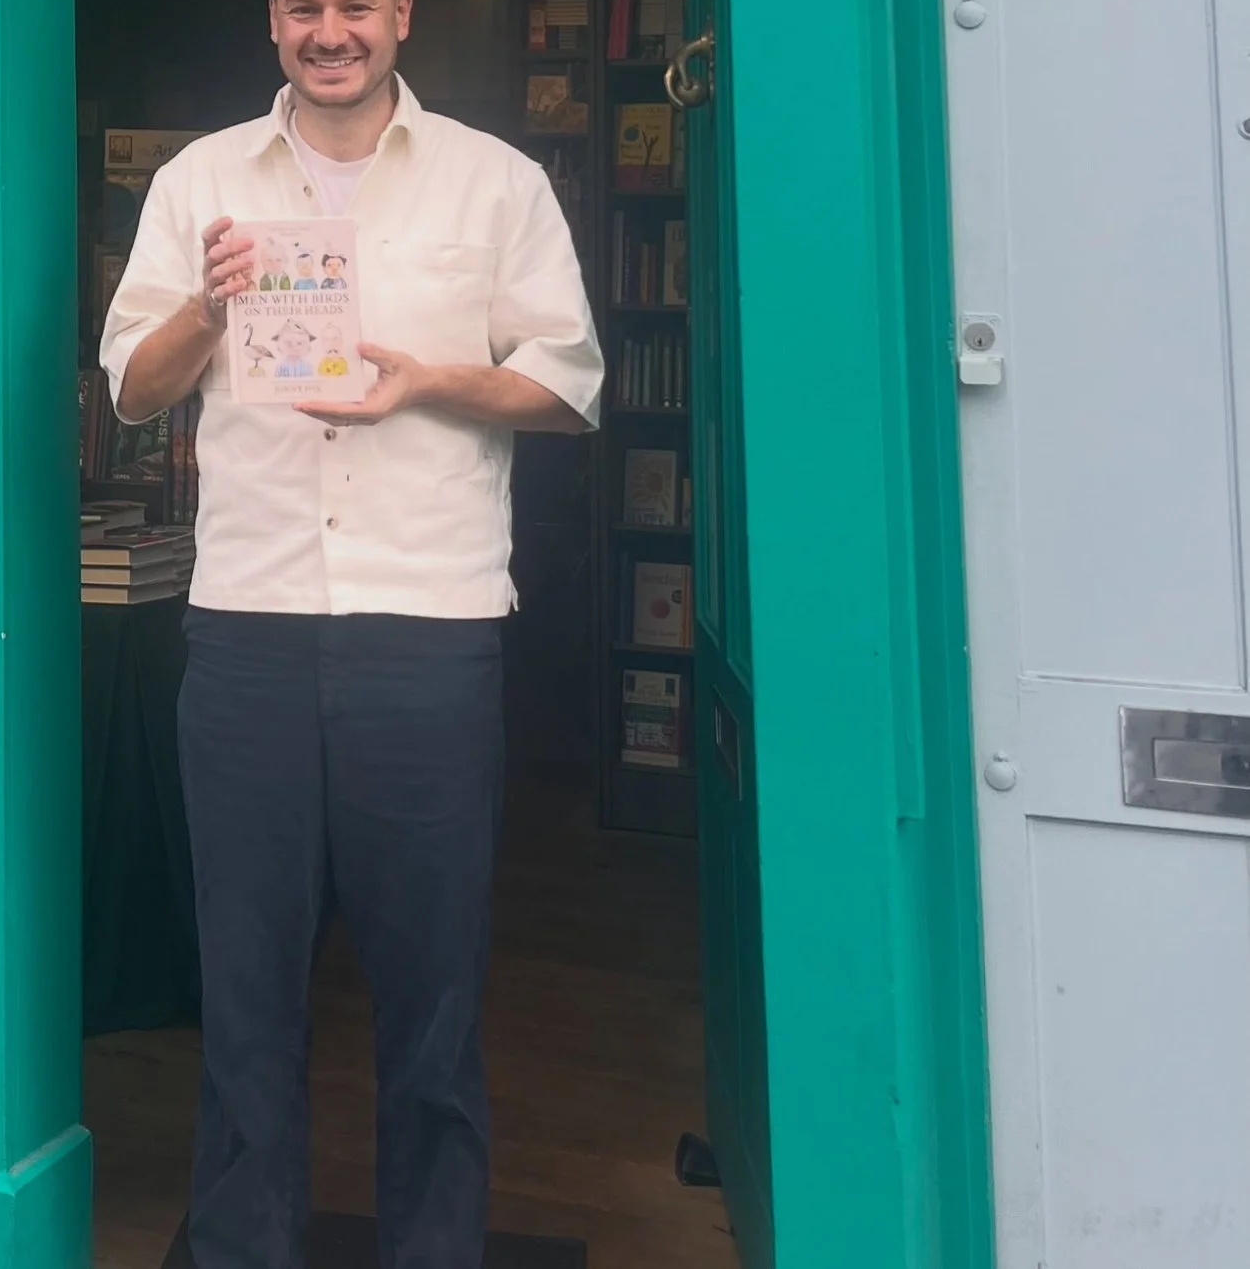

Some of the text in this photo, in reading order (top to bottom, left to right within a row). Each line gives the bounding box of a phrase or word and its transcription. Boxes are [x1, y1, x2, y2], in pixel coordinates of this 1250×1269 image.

[238, 292, 350, 306] MEN WITH BIRDS
[244, 304, 343, 316] ON THEIR HEADS
[157, 408, 170, 445] OUSE
